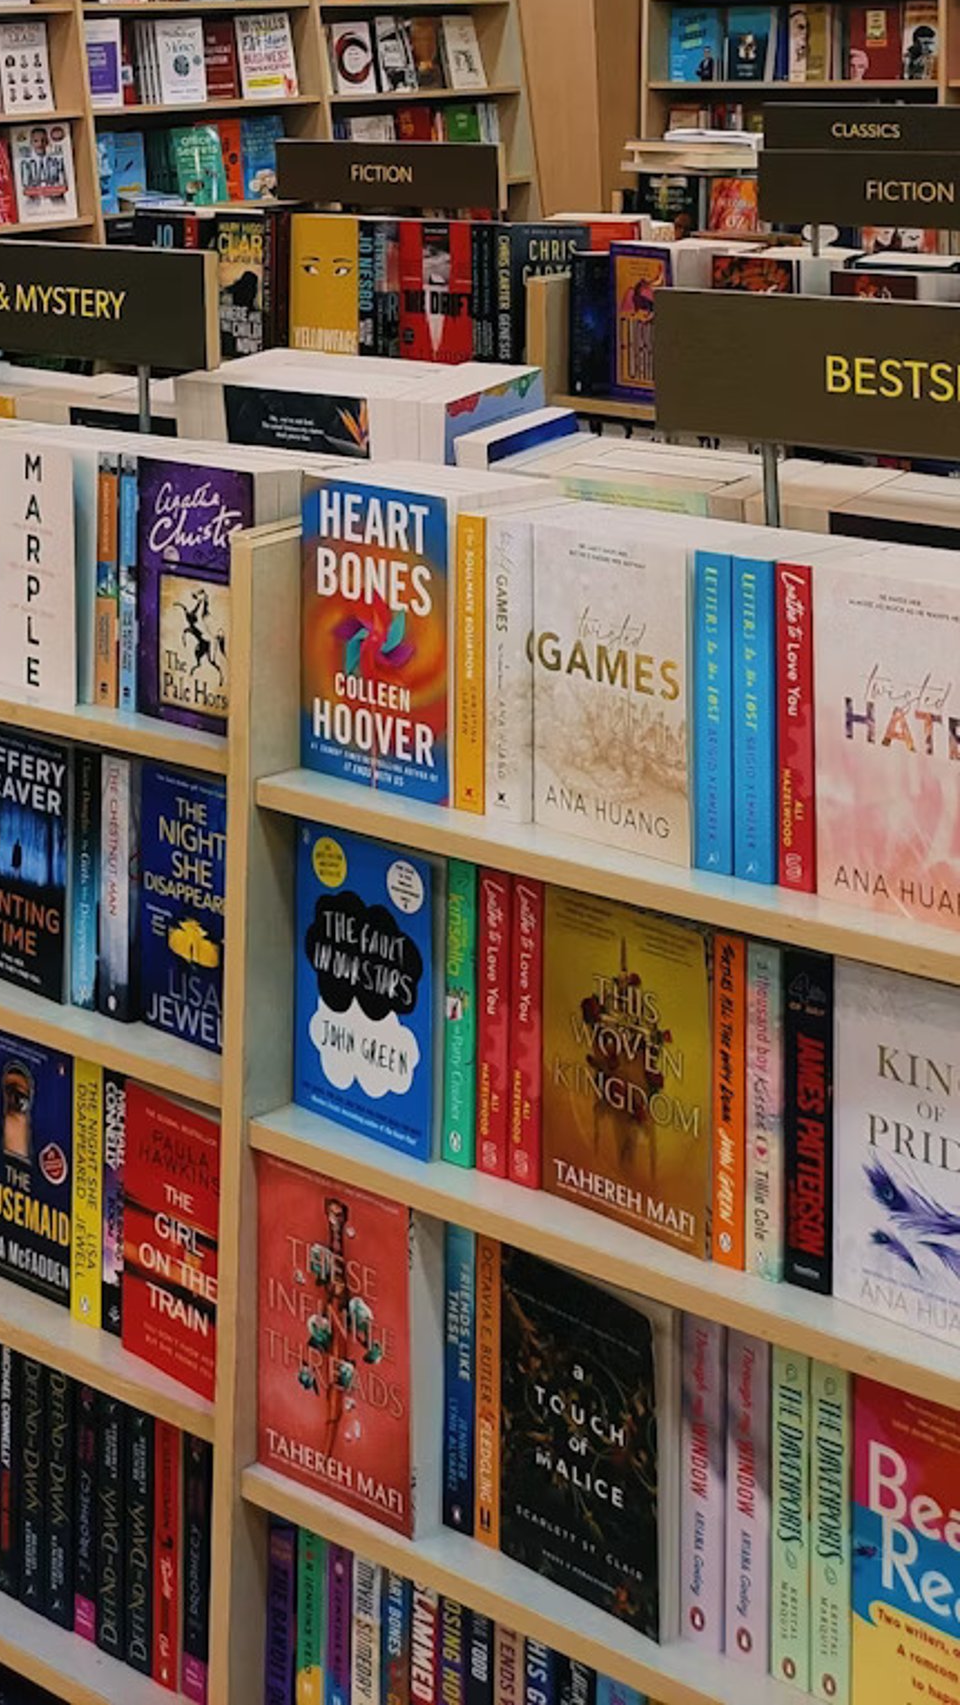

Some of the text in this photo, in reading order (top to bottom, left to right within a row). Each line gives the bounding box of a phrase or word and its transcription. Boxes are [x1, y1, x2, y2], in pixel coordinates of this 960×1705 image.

[832, 123, 900, 139] CLASSICS
[351, 164, 413, 184] FICTION
[865, 180, 955, 203] FICTION
[360, 231, 374, 253] JO
[529, 238, 578, 262] CHRIS
[14, 285, 126, 322] MYSTERY
[825, 355, 960, 403] BESTS
[153, 481, 221, 515] Agatha
[319, 489, 430, 556] HEART
[149, 504, 243, 552] Christie
[25, 453, 42, 687] MARPLE
[315, 546, 432, 617] BONES
[495, 573, 508, 634] GAMES
[165, 649, 188, 673] The
[538, 631, 681, 702] GAMES
[787, 642, 801, 717] Love You
[163, 671, 229, 710] Pale Hors
[334, 672, 411, 714] COLLEEN
[312, 697, 435, 768] HOOVER
[175, 796, 208, 827] THE
[545, 784, 671, 839] ANA HUANG
[108, 797, 121, 879] CHESTNUT
[158, 815, 227, 863] NIGHT
[171, 850, 214, 889] SHE
[107, 881, 119, 917] MAN
[360, 925, 406, 966] FAULT
[167, 967, 221, 1009] LISA
[331, 951, 413, 1006] OUR STARS
[321, 1018, 409, 1073] JOHN GREEN
[570, 1020, 684, 1080] WOVEN
[553, 1059, 701, 1137] KINGDOM
[76, 1084, 89, 1201] DISAPPEARED
[795, 1031, 826, 1257] JAMES PATTERSON
[5, 1165, 32, 1193] THE
[163, 1184, 195, 1215] THE
[553, 1158, 696, 1235] TAHEREH MAFI
[153, 1211, 205, 1258] GIRL
[7, 1240, 70, 1291] McFADDEN
[138, 1242, 219, 1304] ON THE
[145, 1281, 209, 1337] TRAIN
[533, 1384, 627, 1448] TOUCH
[264, 1426, 404, 1515] TAHEREH MAFI
[568, 1436, 588, 1458] of
[689, 1421, 709, 1501] WINDOW
[775, 1421, 805, 1553] DAVENPORTS
[815, 1435, 844, 1565] DAVENPORTS
[877, 1608, 902, 1629] Two
